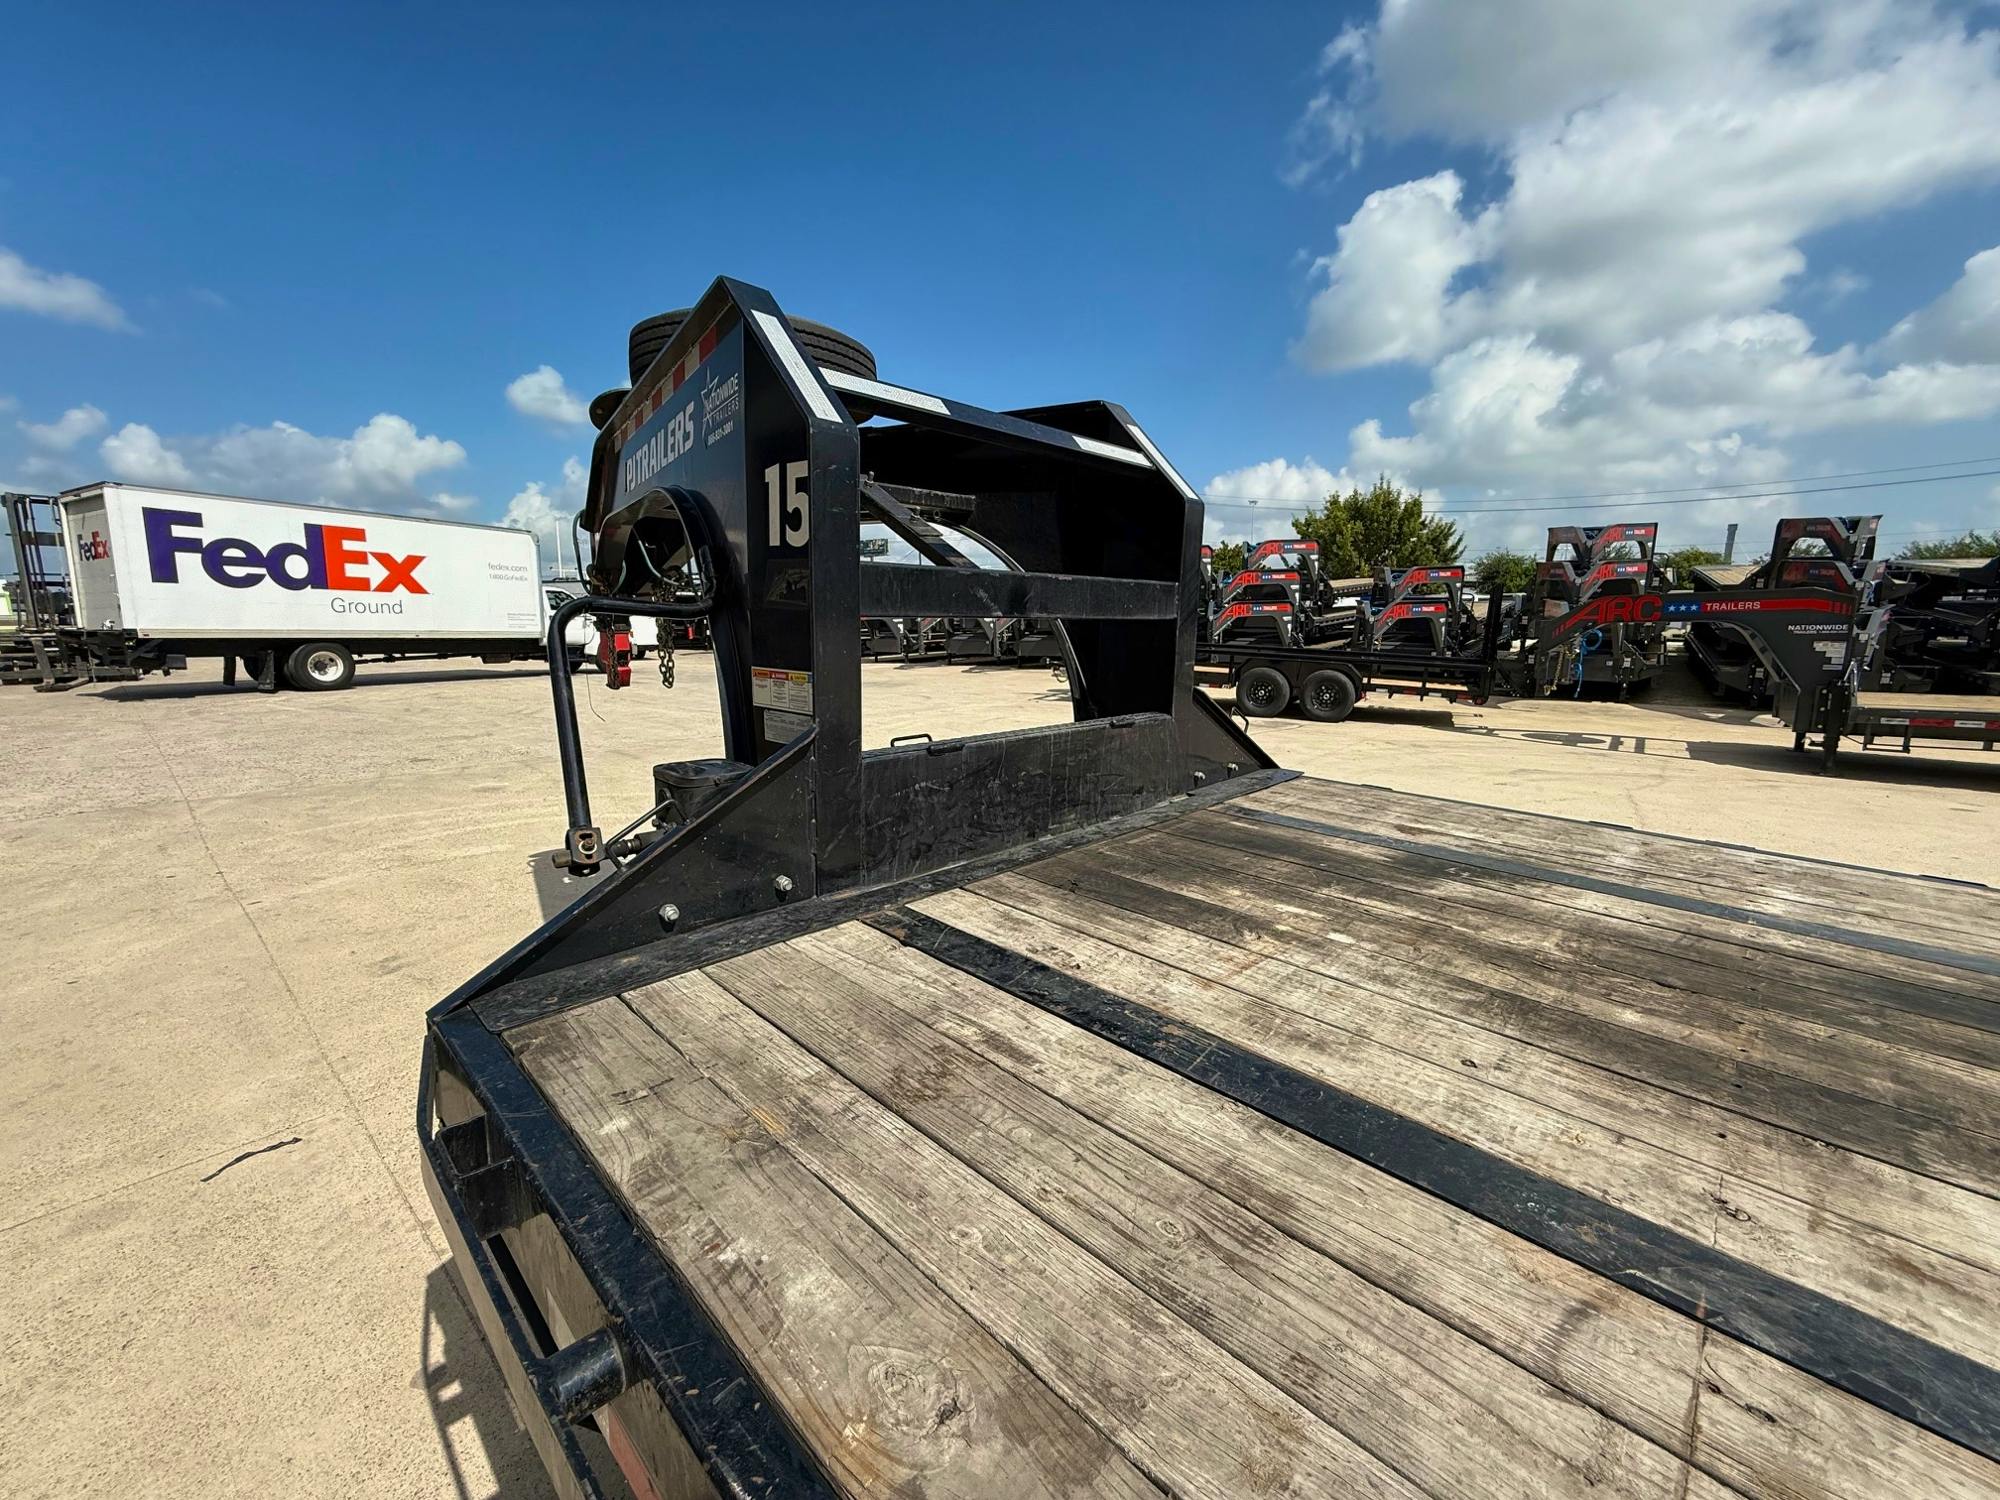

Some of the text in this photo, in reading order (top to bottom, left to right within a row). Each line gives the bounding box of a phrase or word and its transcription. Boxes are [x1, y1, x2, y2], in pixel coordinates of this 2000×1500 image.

[712, 397, 739, 427] TRAILERS
[765, 460, 810, 547] 15
[77, 531, 110, 561] FedEx
[142, 506, 430, 595] FedEx
[488, 562, 528, 573] fedex.com
[331, 596, 404, 615] Ground
[1566, 594, 1761, 624] ARC TRAILERS
[1787, 623, 1849, 632] NATIONWIDE
